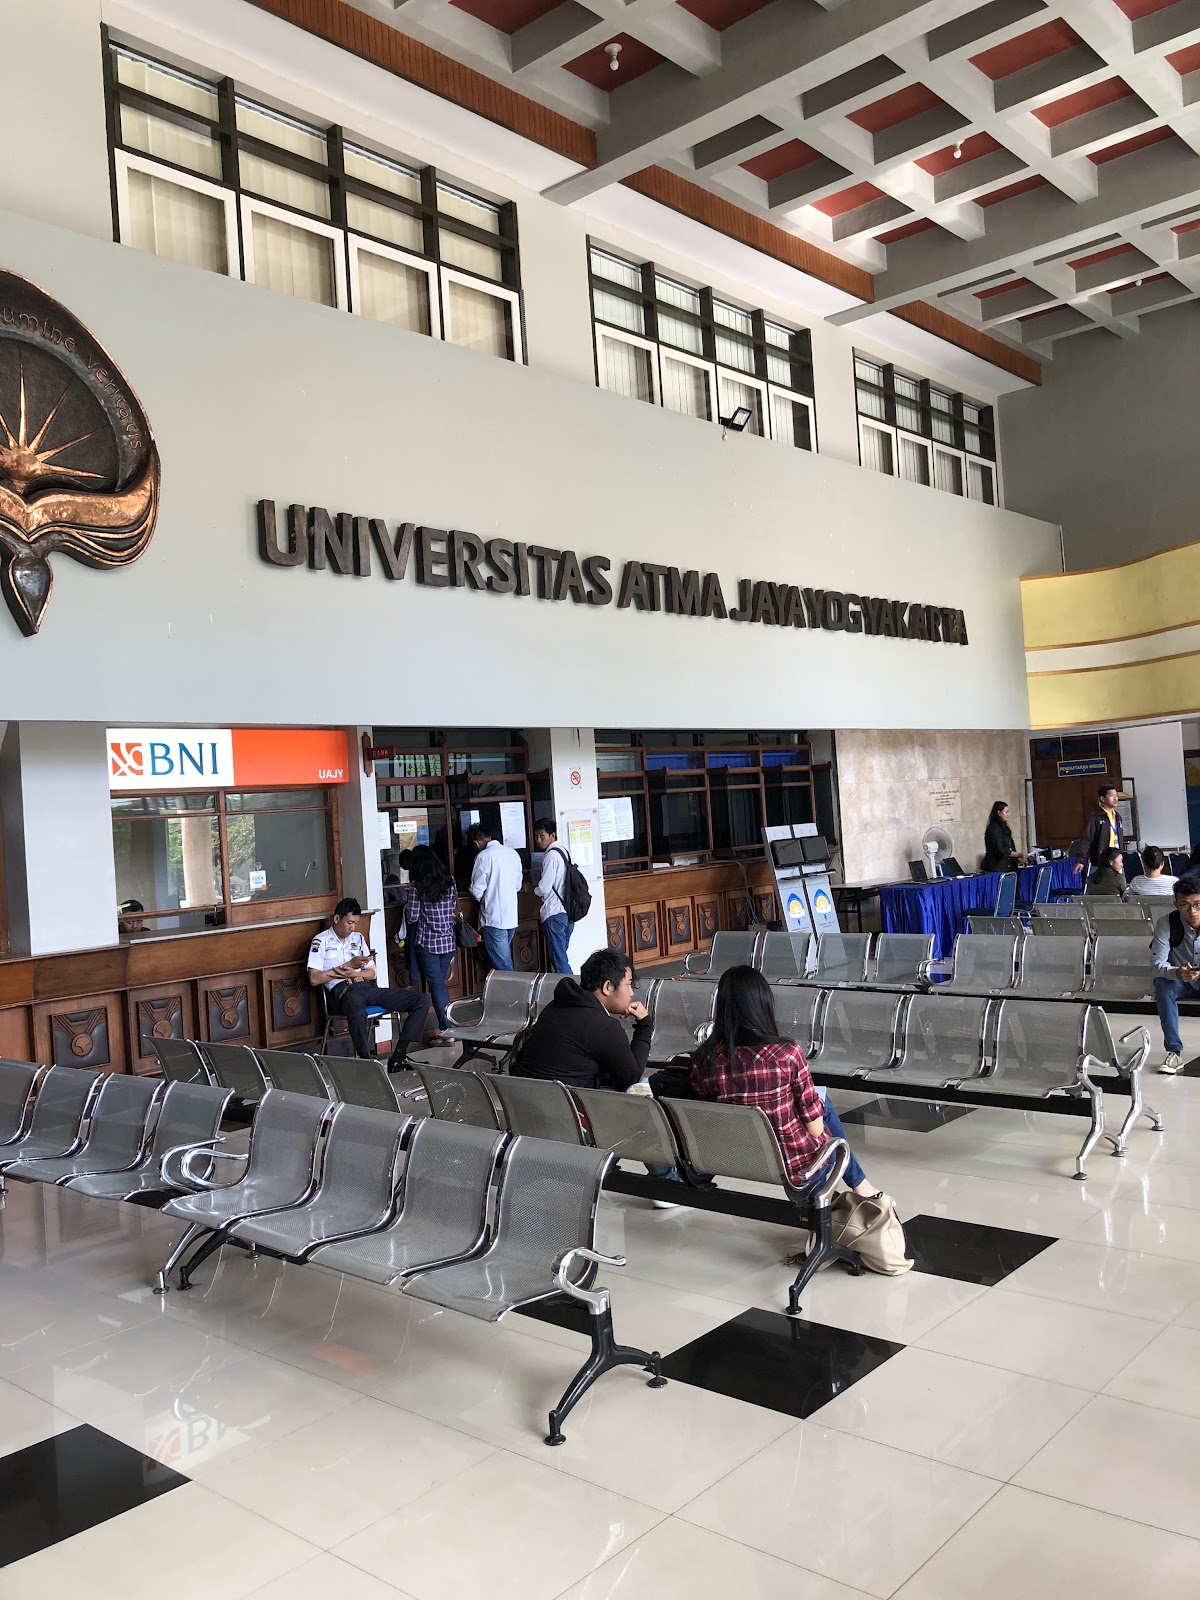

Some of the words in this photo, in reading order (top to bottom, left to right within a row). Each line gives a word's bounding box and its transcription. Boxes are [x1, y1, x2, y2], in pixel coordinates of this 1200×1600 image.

[3, 307, 76, 353] umine
[257, 499, 613, 605] UNIVERSITAS
[617, 560, 728, 619] ATMA
[149, 742, 219, 776] BNI
[372, 749, 389, 758] BANK
[318, 769, 344, 779] UAJY
